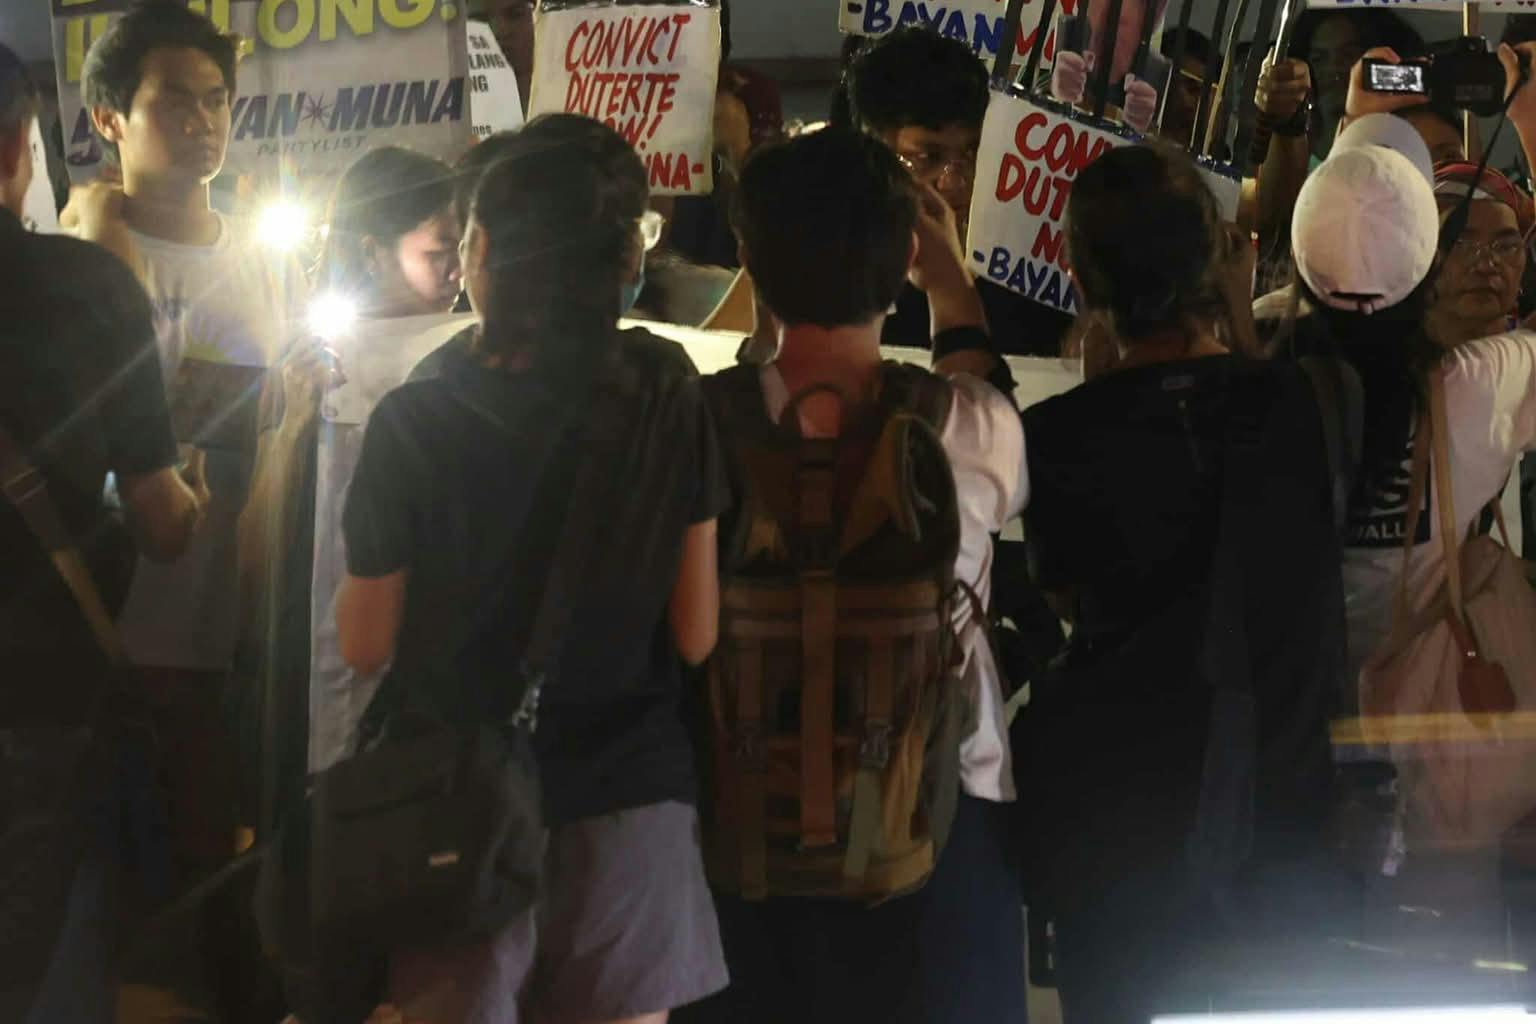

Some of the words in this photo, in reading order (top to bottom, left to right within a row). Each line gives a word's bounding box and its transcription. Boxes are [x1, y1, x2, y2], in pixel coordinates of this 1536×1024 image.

[565, 13, 691, 73] CONVICT
[328, 77, 465, 132] MUNA
[565, 72, 681, 120] DUTERTE
